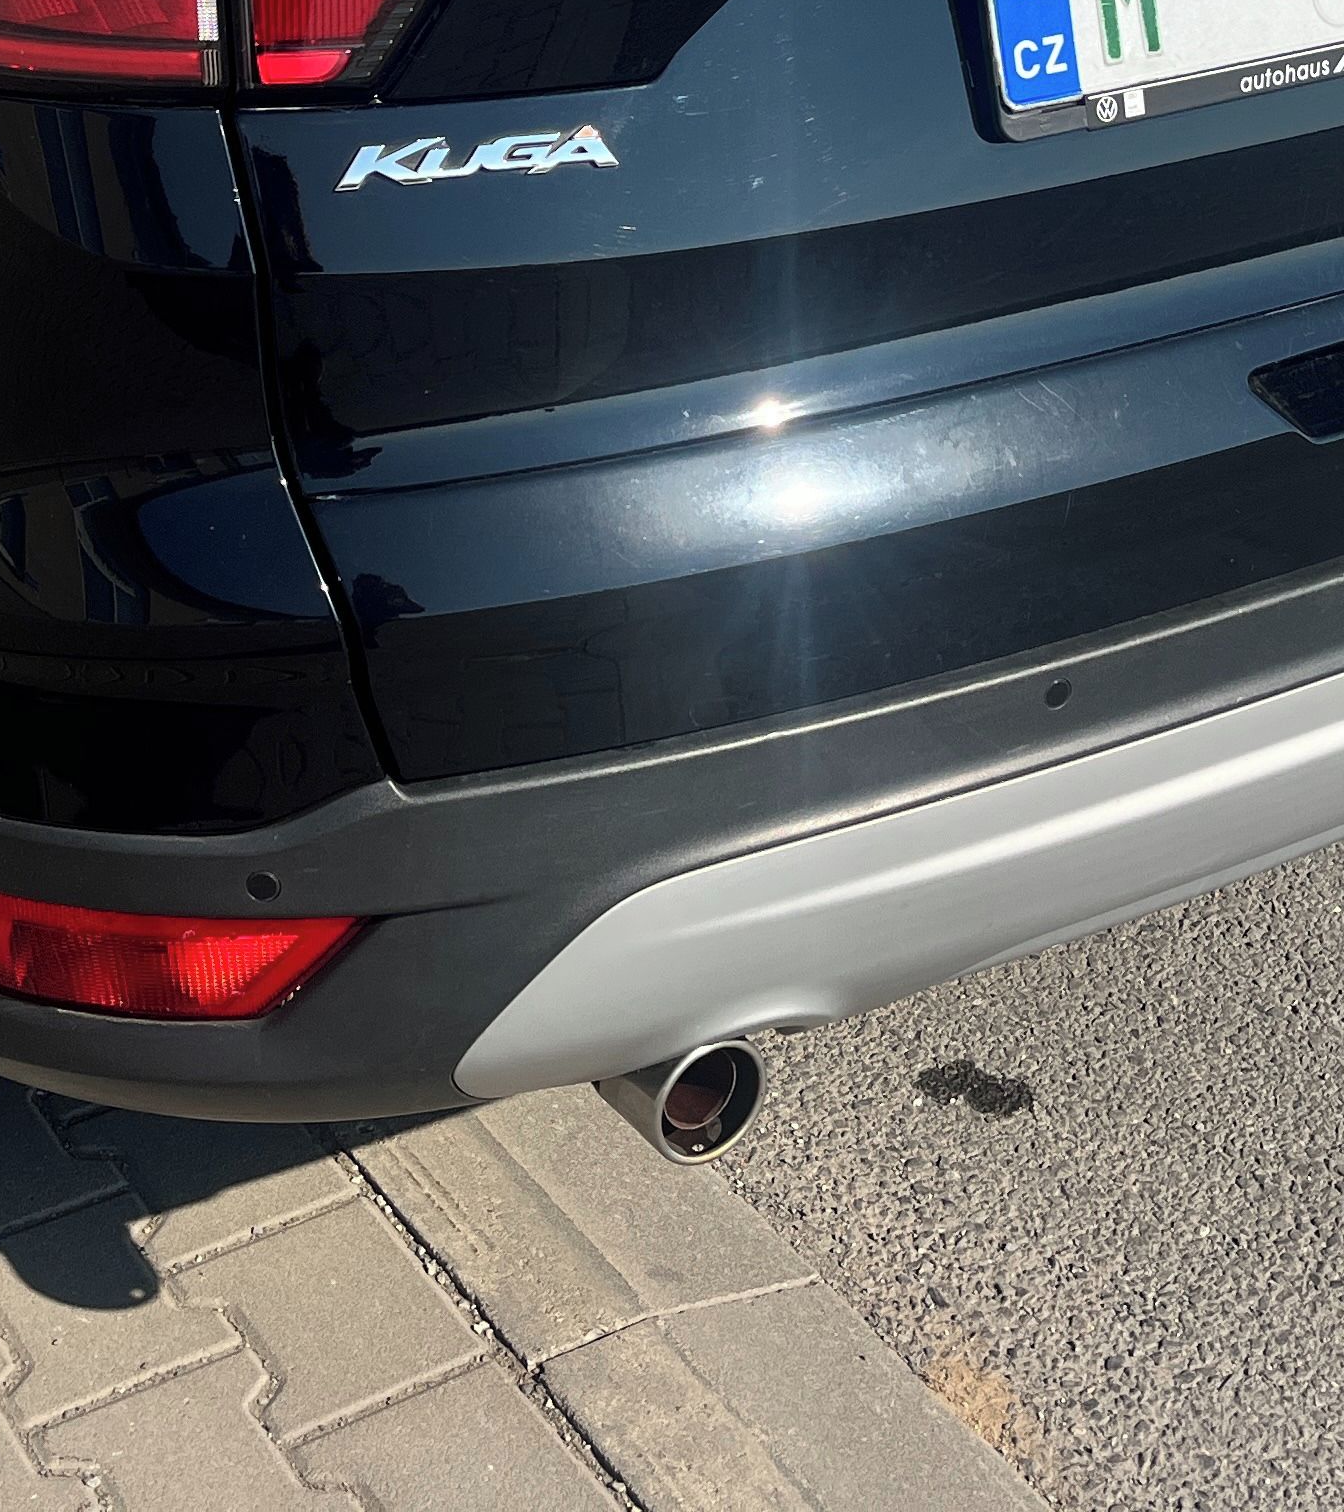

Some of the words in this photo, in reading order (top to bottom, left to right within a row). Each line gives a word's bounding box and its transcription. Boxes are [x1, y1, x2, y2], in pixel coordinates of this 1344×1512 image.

[1013, 33, 1068, 80] CZ
[1239, 58, 1331, 93] autohaus
[333, 124, 620, 193] KUGA
